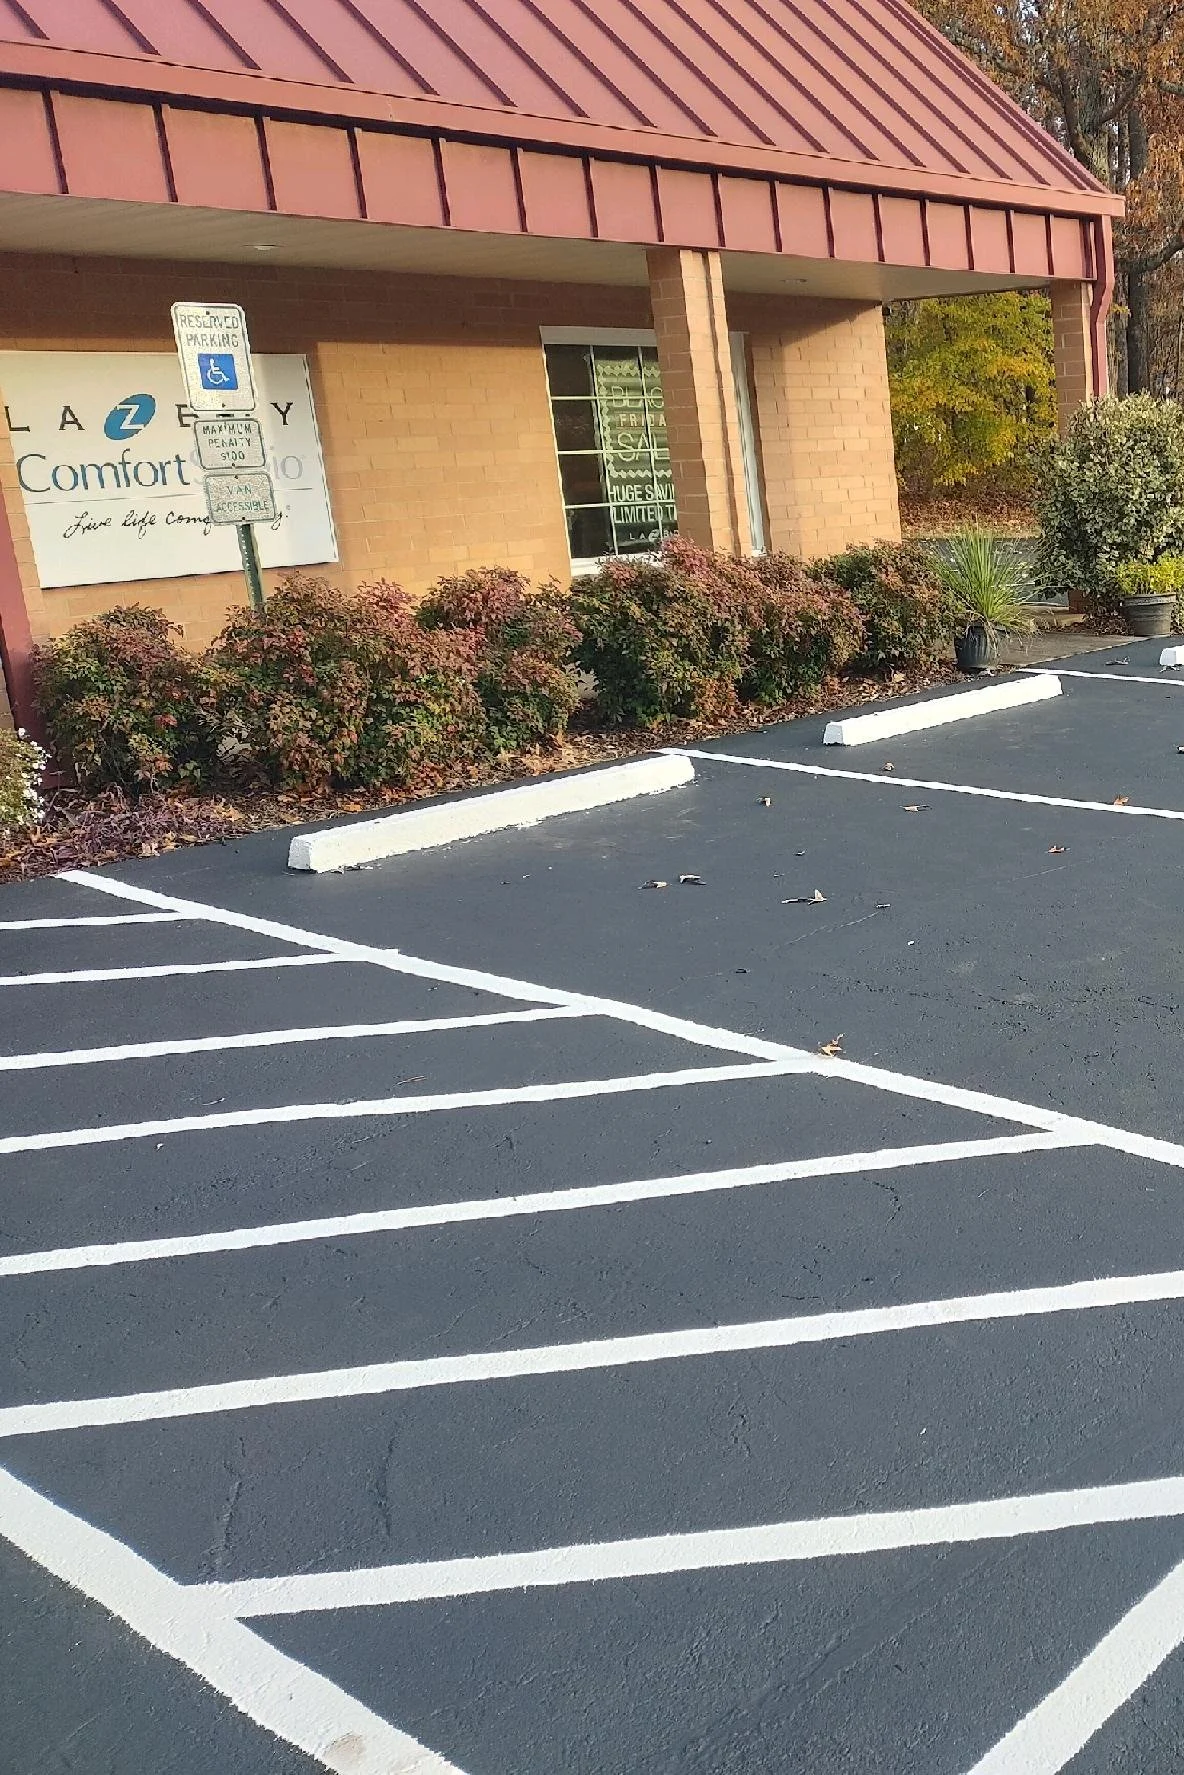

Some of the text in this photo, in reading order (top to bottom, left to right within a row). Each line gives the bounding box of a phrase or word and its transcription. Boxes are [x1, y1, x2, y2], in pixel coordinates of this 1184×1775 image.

[180, 314, 240, 329] RESERVED
[186, 333, 240, 348] PARKING
[611, 385, 665, 409] BLAC
[619, 413, 667, 428] FRIDA
[202, 422, 252, 435] MAXIMUM
[617, 432, 671, 461] SAL
[226, 485, 252, 495] VAN
[62, 511, 112, 539] Live
